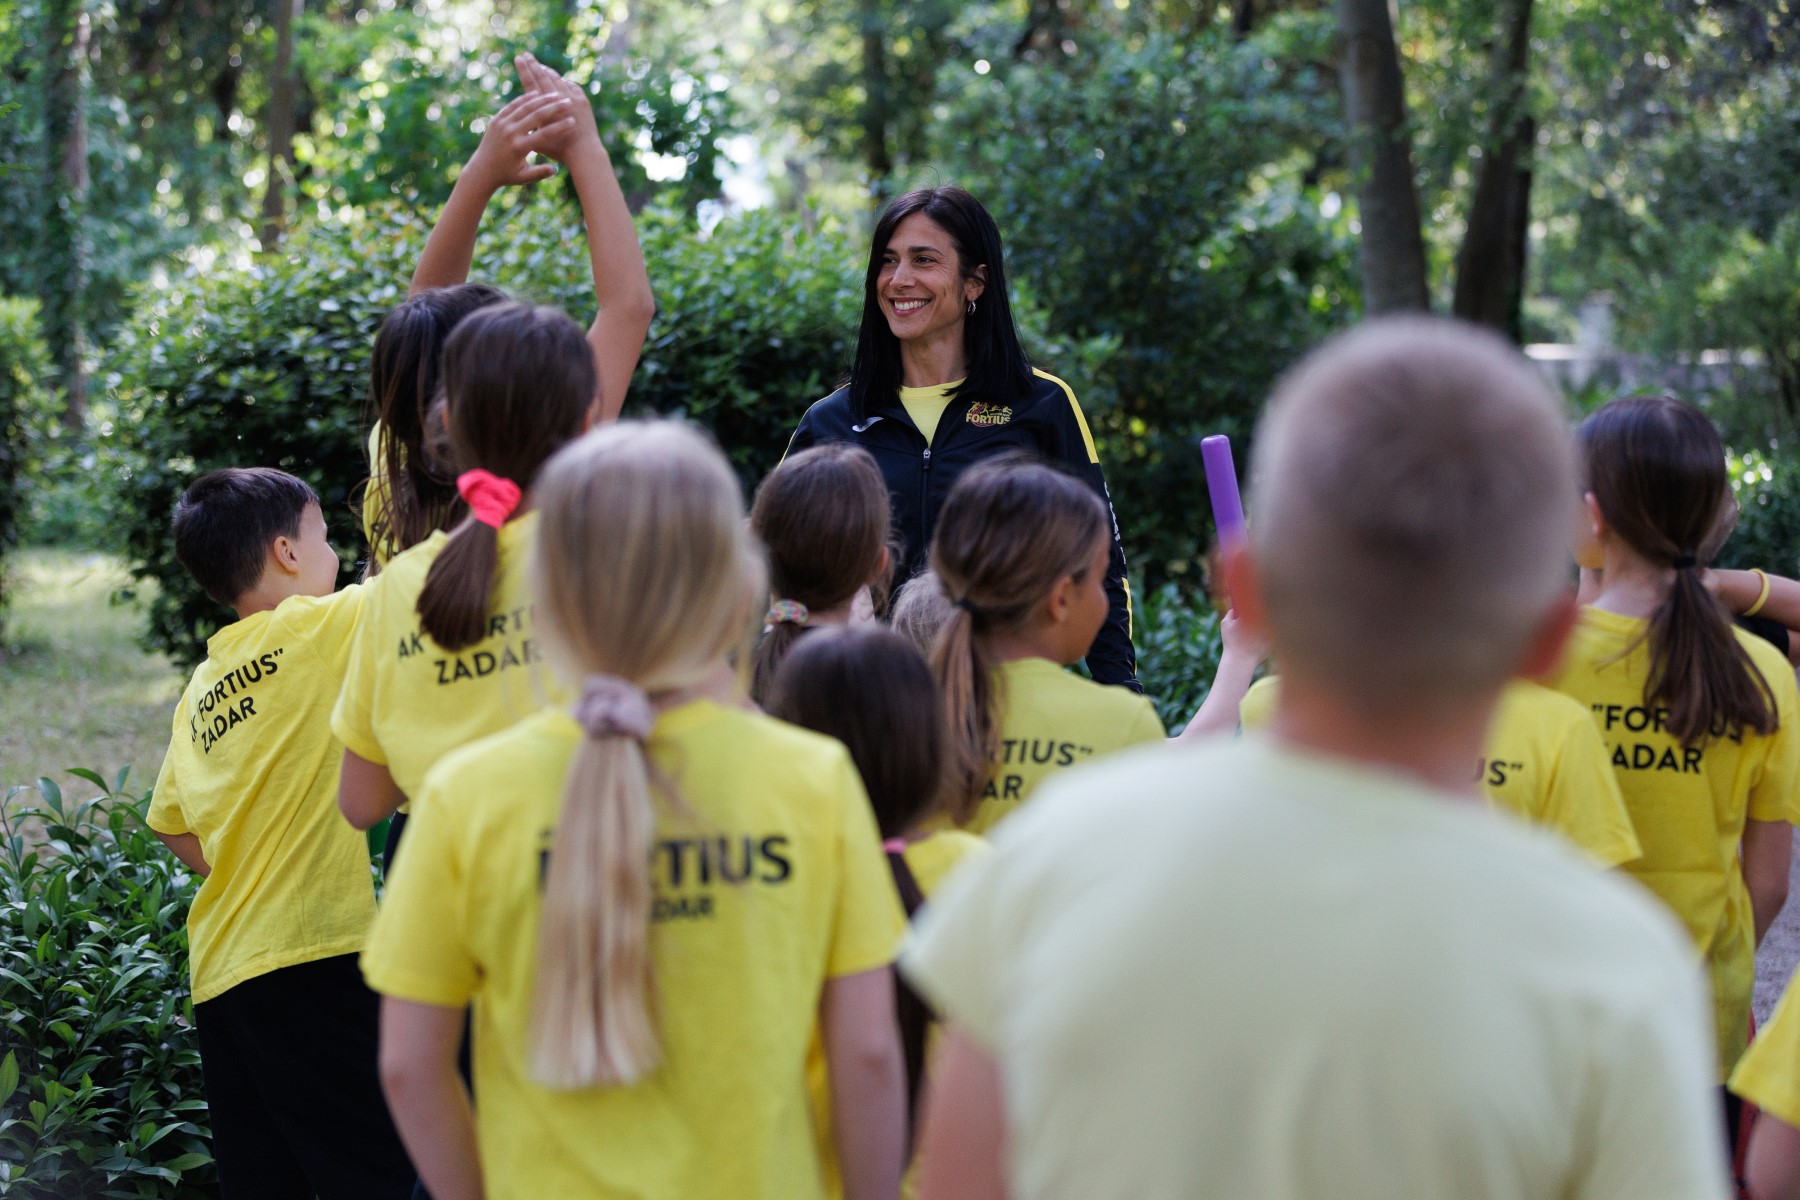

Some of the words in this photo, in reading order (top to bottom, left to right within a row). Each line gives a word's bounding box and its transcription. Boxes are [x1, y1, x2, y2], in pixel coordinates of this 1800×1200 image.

[965, 412, 1011, 425] FORTIUS
[398, 630, 423, 658] AK
[201, 696, 257, 754] ZADAR
[1606, 743, 1702, 774] ADAR
